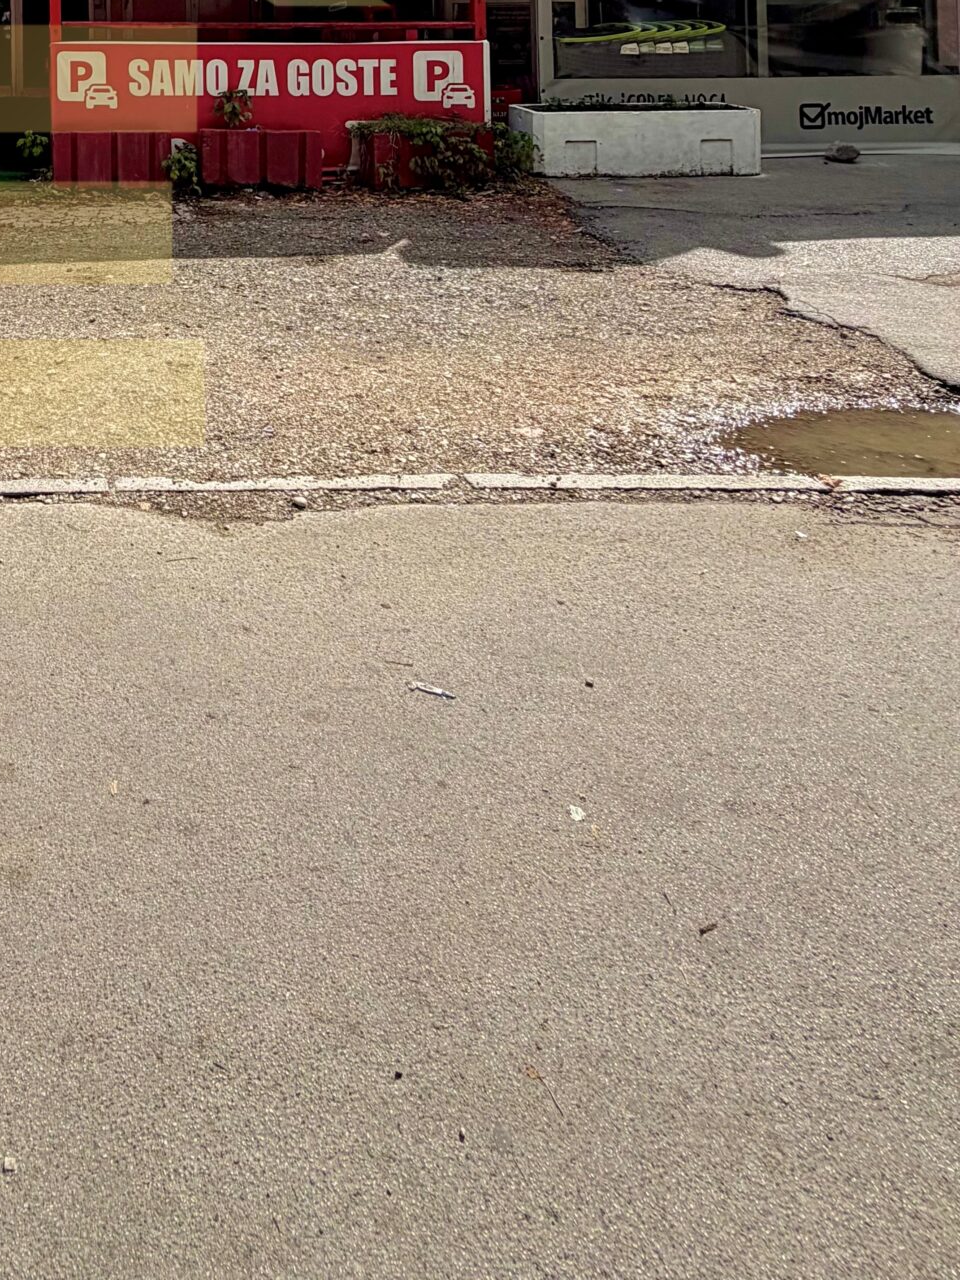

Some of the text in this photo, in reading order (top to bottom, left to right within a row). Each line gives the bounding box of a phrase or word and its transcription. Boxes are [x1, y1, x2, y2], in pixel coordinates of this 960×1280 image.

[70, 60, 93, 91] P
[128, 59, 398, 97] SAMO ZA GOSTE
[427, 60, 450, 91] P
[827, 105, 934, 130] mojMarket
